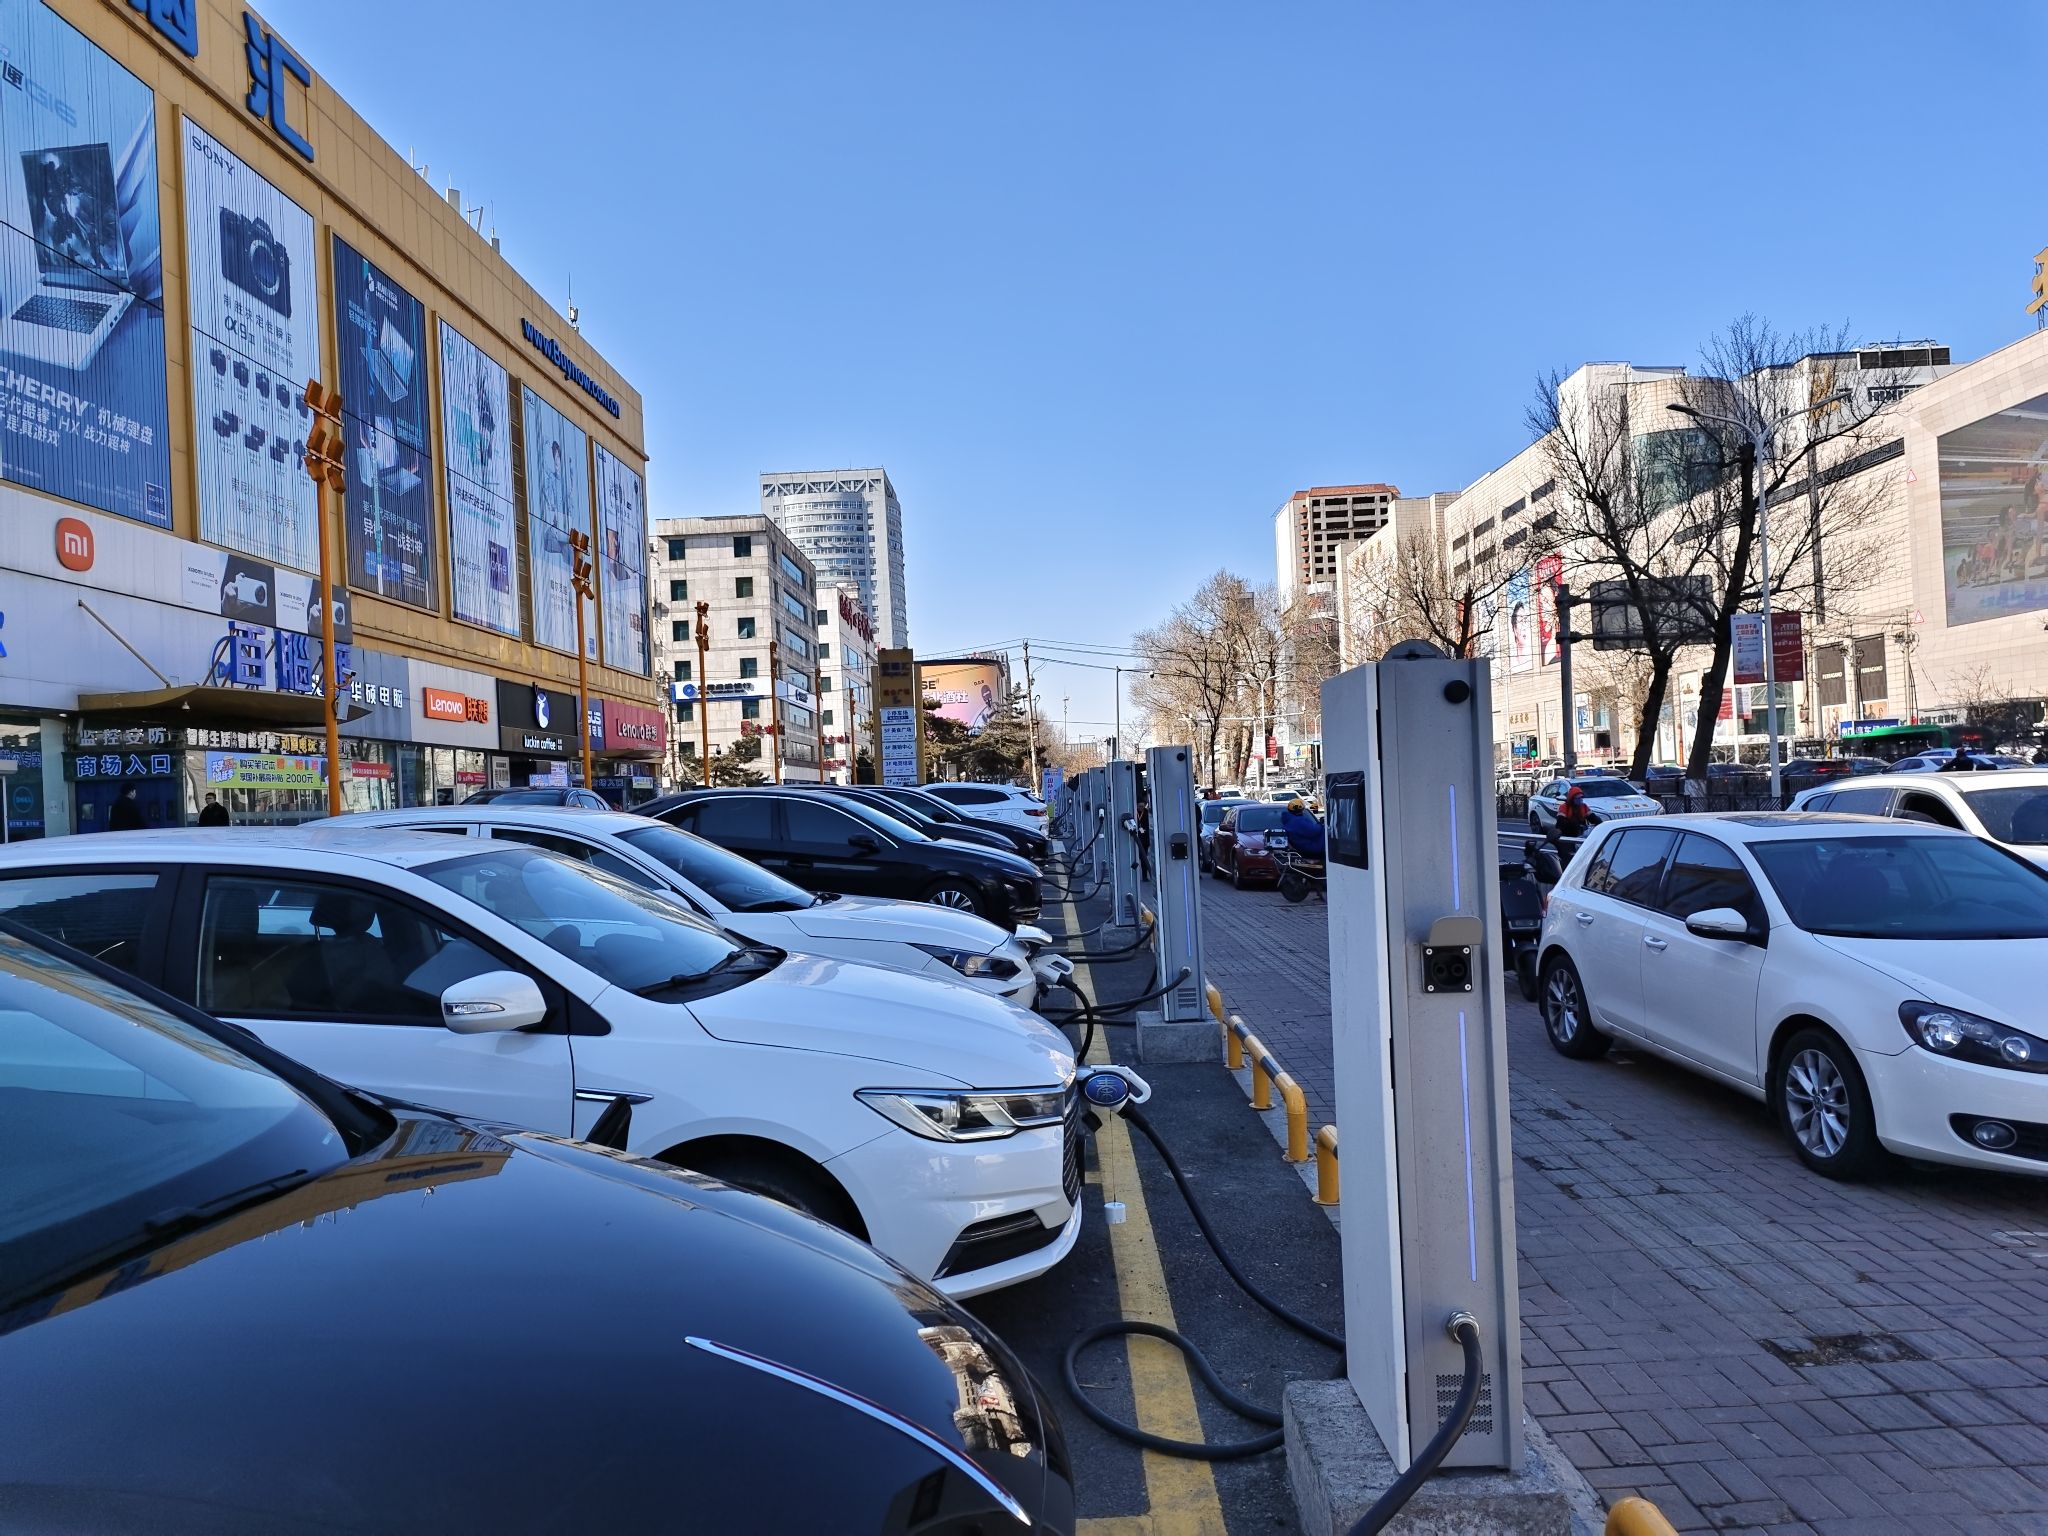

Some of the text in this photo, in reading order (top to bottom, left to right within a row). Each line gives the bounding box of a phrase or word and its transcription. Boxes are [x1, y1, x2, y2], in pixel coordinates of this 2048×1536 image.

[191, 135, 236, 177] SONY
[350, 680, 403, 709] 华硕电脑
[430, 693, 489, 725] Lenovo 联想
[79, 727, 167, 746] 监控安防
[616, 718, 645, 740] Lenovo
[524, 734, 540, 749] luckin
[540, 737, 556, 751] coffee
[77, 754, 171, 777] 商场入口
[239, 758, 276, 771] 购买笔记本
[285, 773, 314, 784] 2000元
